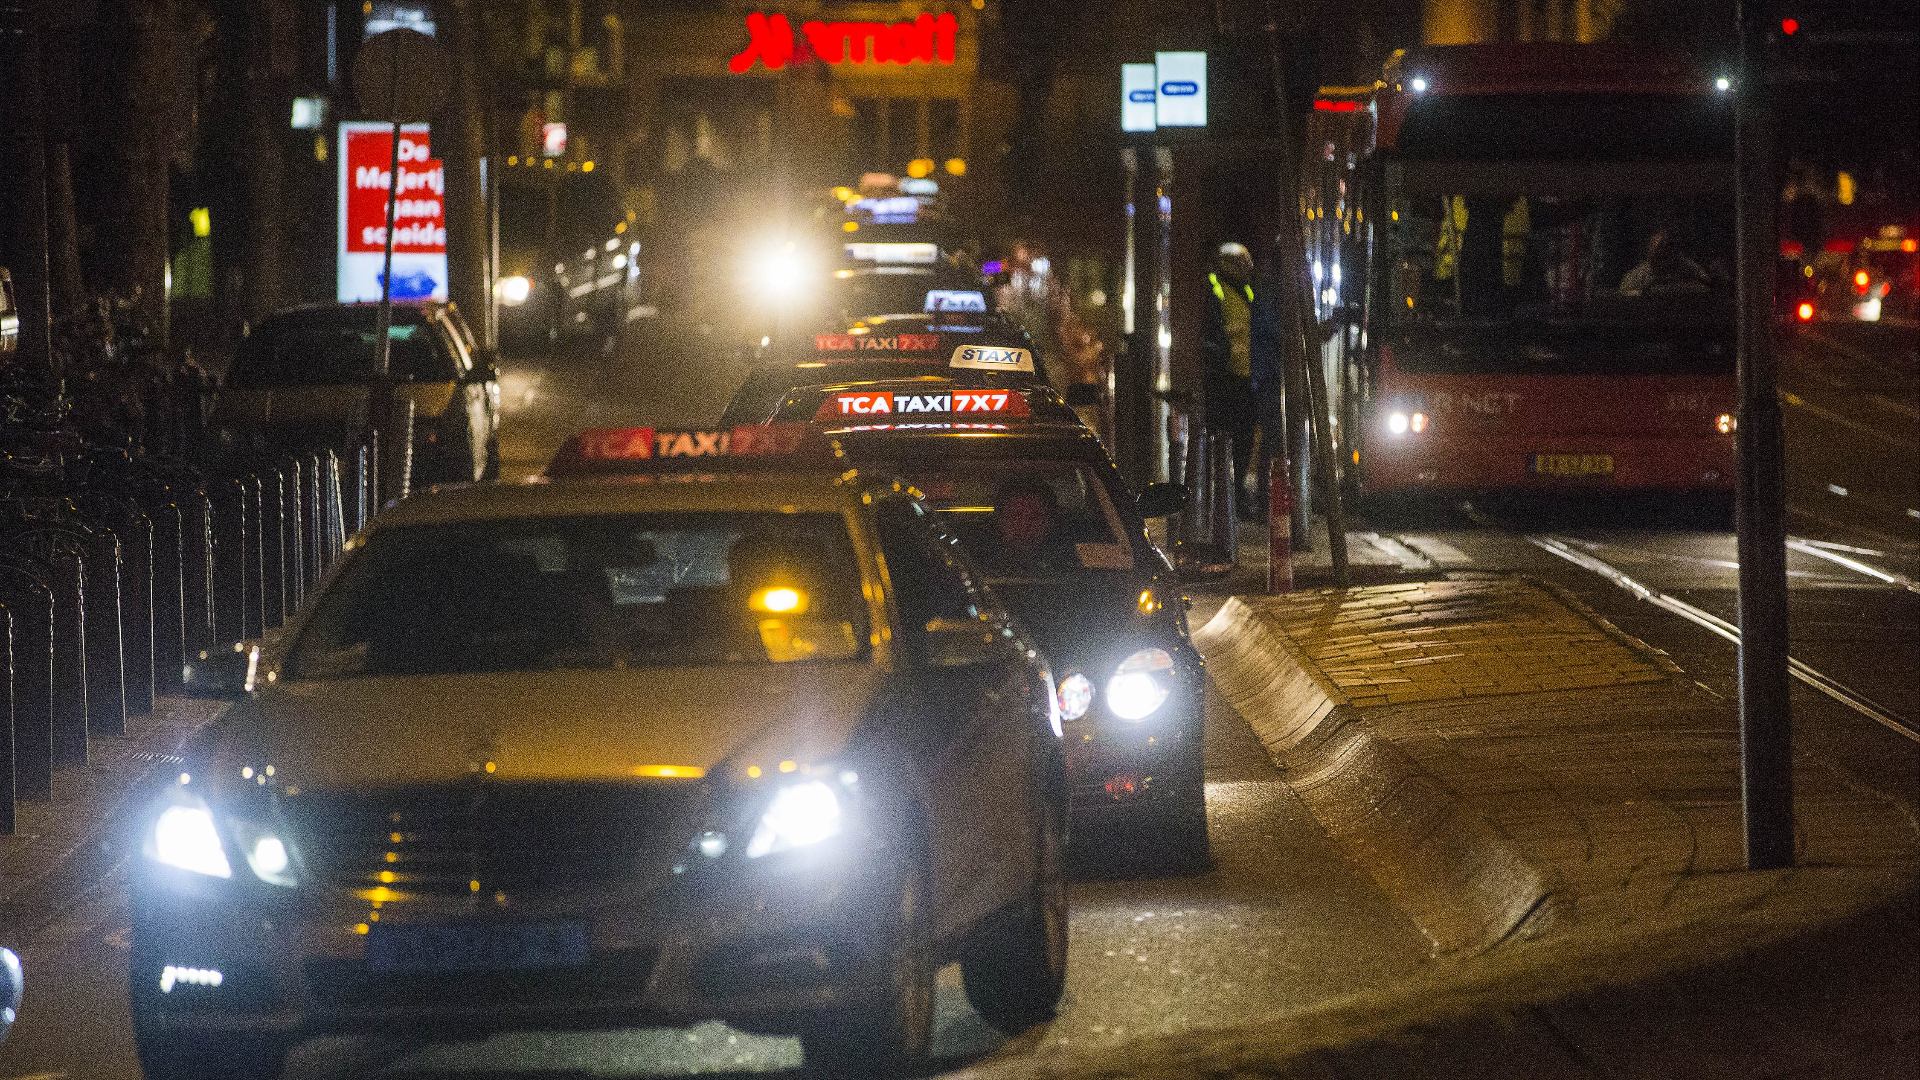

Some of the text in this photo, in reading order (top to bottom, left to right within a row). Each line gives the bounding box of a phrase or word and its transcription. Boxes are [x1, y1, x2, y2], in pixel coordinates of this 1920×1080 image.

[729, 12, 958, 73] Mrriott
[398, 139, 430, 162] De
[356, 166, 444, 195] Mejertj
[857, 338, 898, 350] TAXI
[962, 348, 1022, 364] STAXI
[838, 394, 1008, 414] TCA TAXI 7X7
[583, 432, 649, 458] TCA
[656, 431, 730, 457] TAXI
